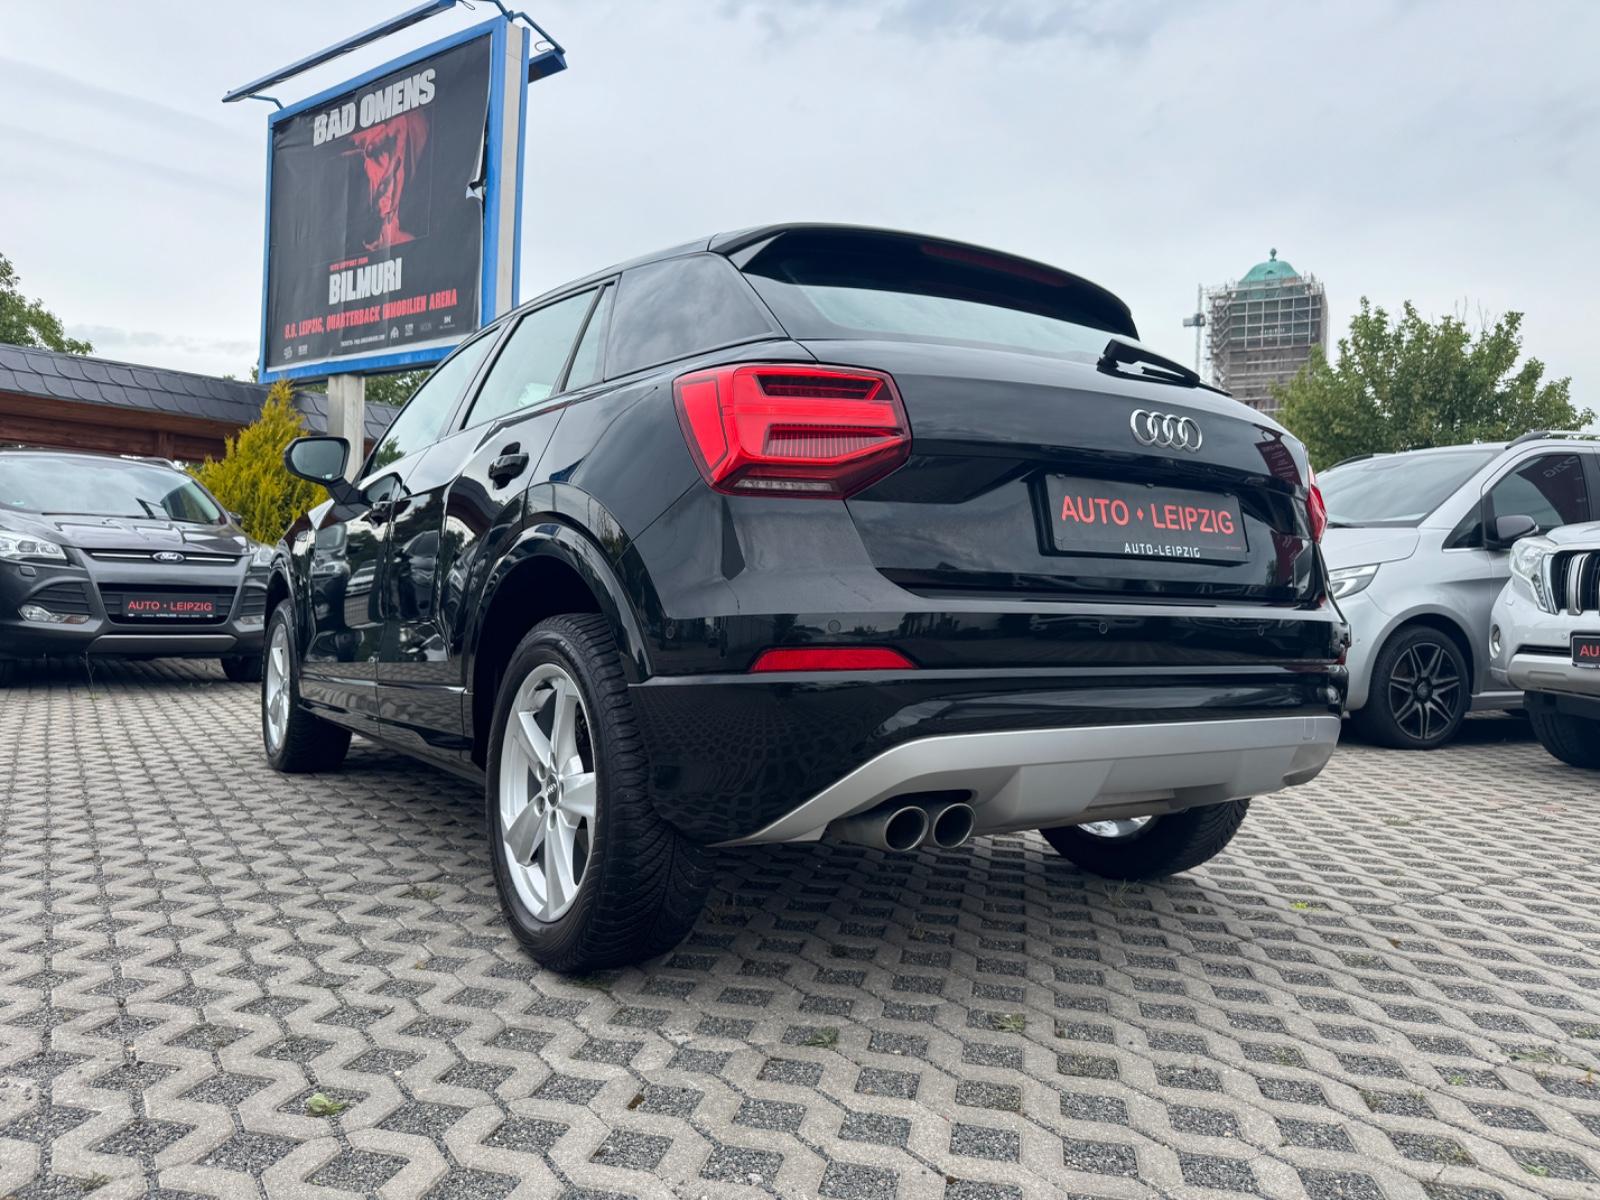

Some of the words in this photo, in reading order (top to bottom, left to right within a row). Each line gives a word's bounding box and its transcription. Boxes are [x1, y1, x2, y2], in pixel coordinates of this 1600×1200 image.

[313, 102, 356, 147] BAD
[360, 68, 436, 128] OMENS
[328, 257, 402, 306] BILMURI
[299, 316, 325, 337] LEIPZIG,
[326, 305, 380, 333] QUARTERBACK
[382, 295, 427, 320] IMMOBILIEN
[429, 288, 457, 311] ARENA
[1061, 495, 1130, 526] AUTO
[1150, 503, 1235, 535] LEIPZIG
[1124, 542, 1201, 559] AUTO-LEIPZIG
[128, 600, 160, 610] AUTO
[170, 602, 213, 611] LEIPZIG
